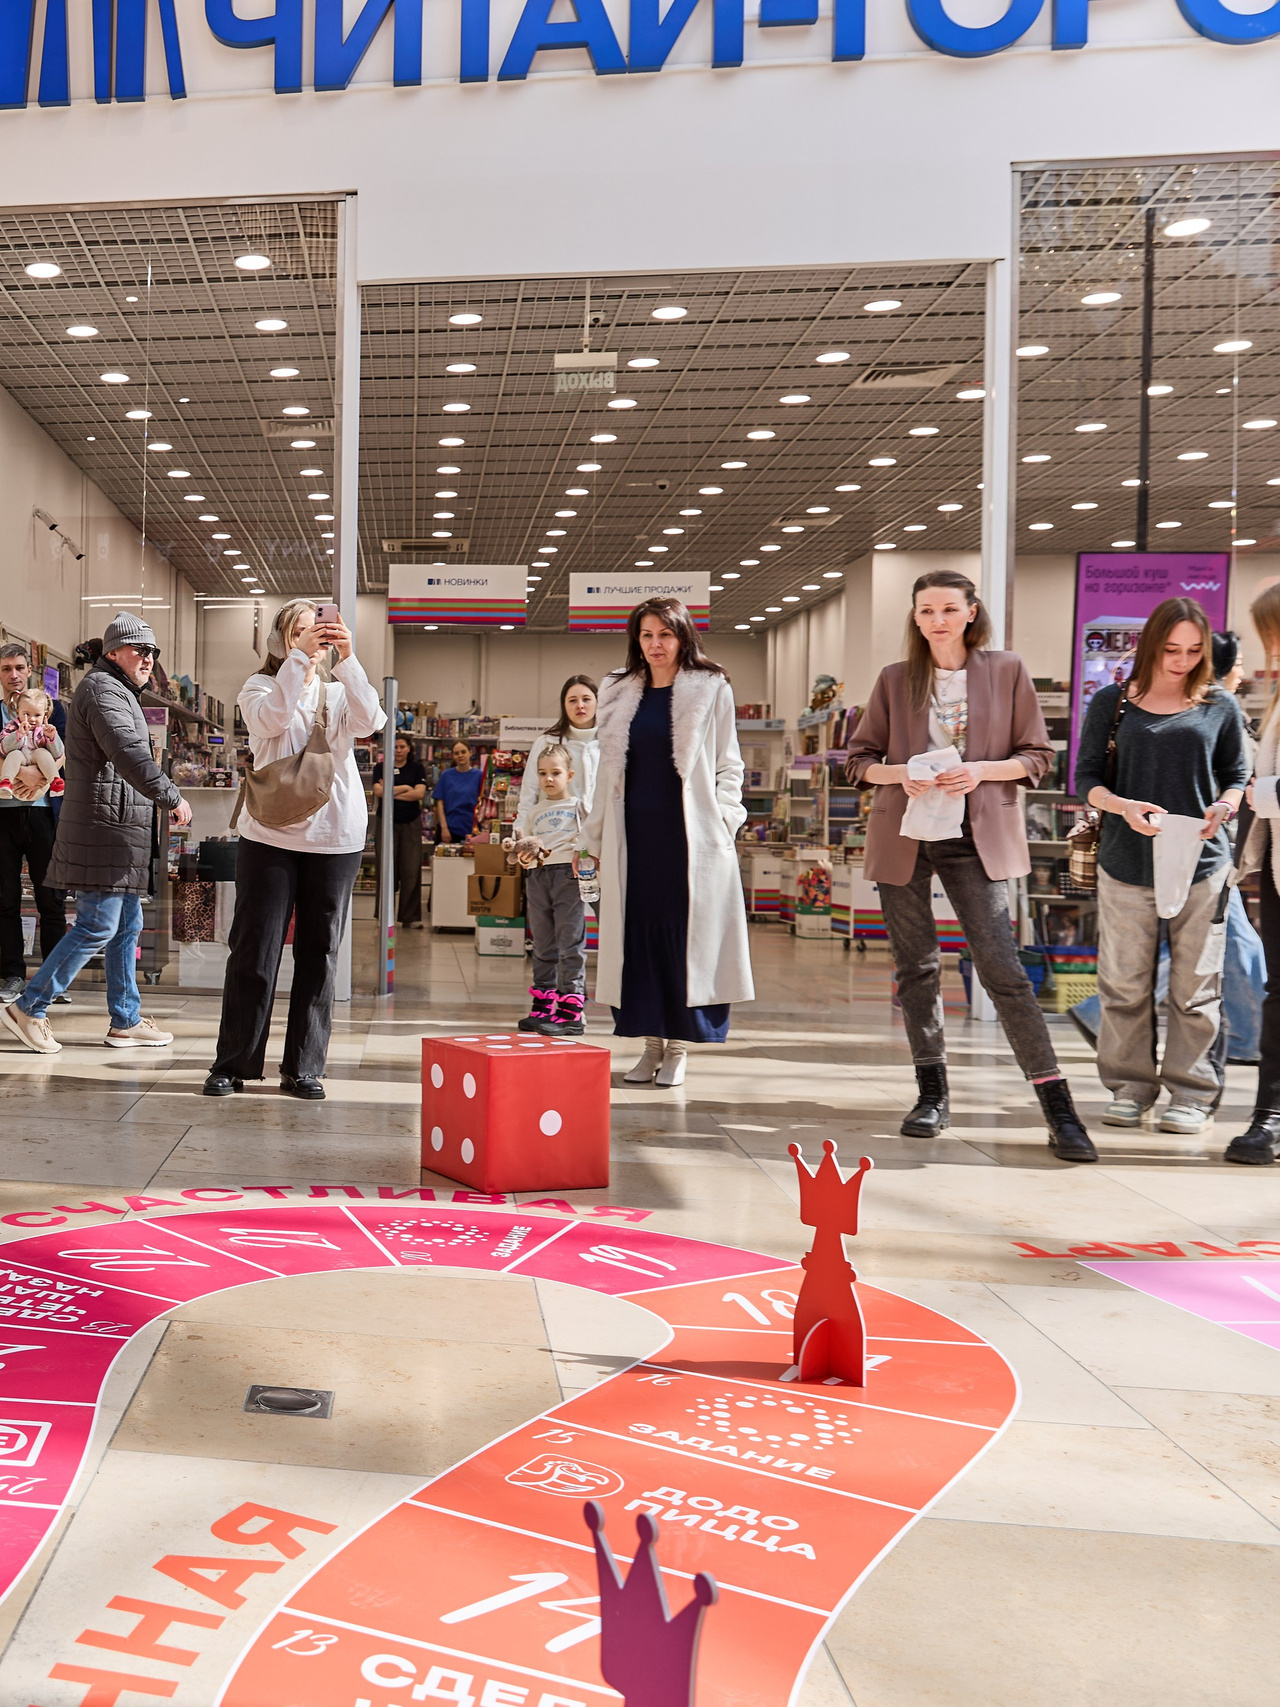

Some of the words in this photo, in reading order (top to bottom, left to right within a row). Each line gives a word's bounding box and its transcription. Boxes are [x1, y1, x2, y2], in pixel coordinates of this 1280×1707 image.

[444, 578, 488, 586] НОВИНКИ
[1085, 565, 1139, 579] Большой
[1143, 569, 1169, 581] куш
[603, 586, 642, 594] ЛУЧШИЕ
[1084, 583, 1100, 593] на
[1, 1187, 655, 1228] СЧАСТЛИВАЯ
[489, 1225, 533, 1259] ЗАДАНИЕ
[57, 1244, 211, 1272] 22
[578, 1244, 677, 1278] 19
[80, 1320, 133, 1333] 23
[636, 1373, 683, 1387] 16
[531, 1428, 586, 1444] 15
[627, 1422, 838, 1480] ЗАДАНИЕ
[641, 1485, 800, 1532] ДОДО
[623, 1499, 818, 1561] ПИЦЦА
[271, 1629, 340, 1657] 13
[360, 1653, 587, 1707] СДЕ
